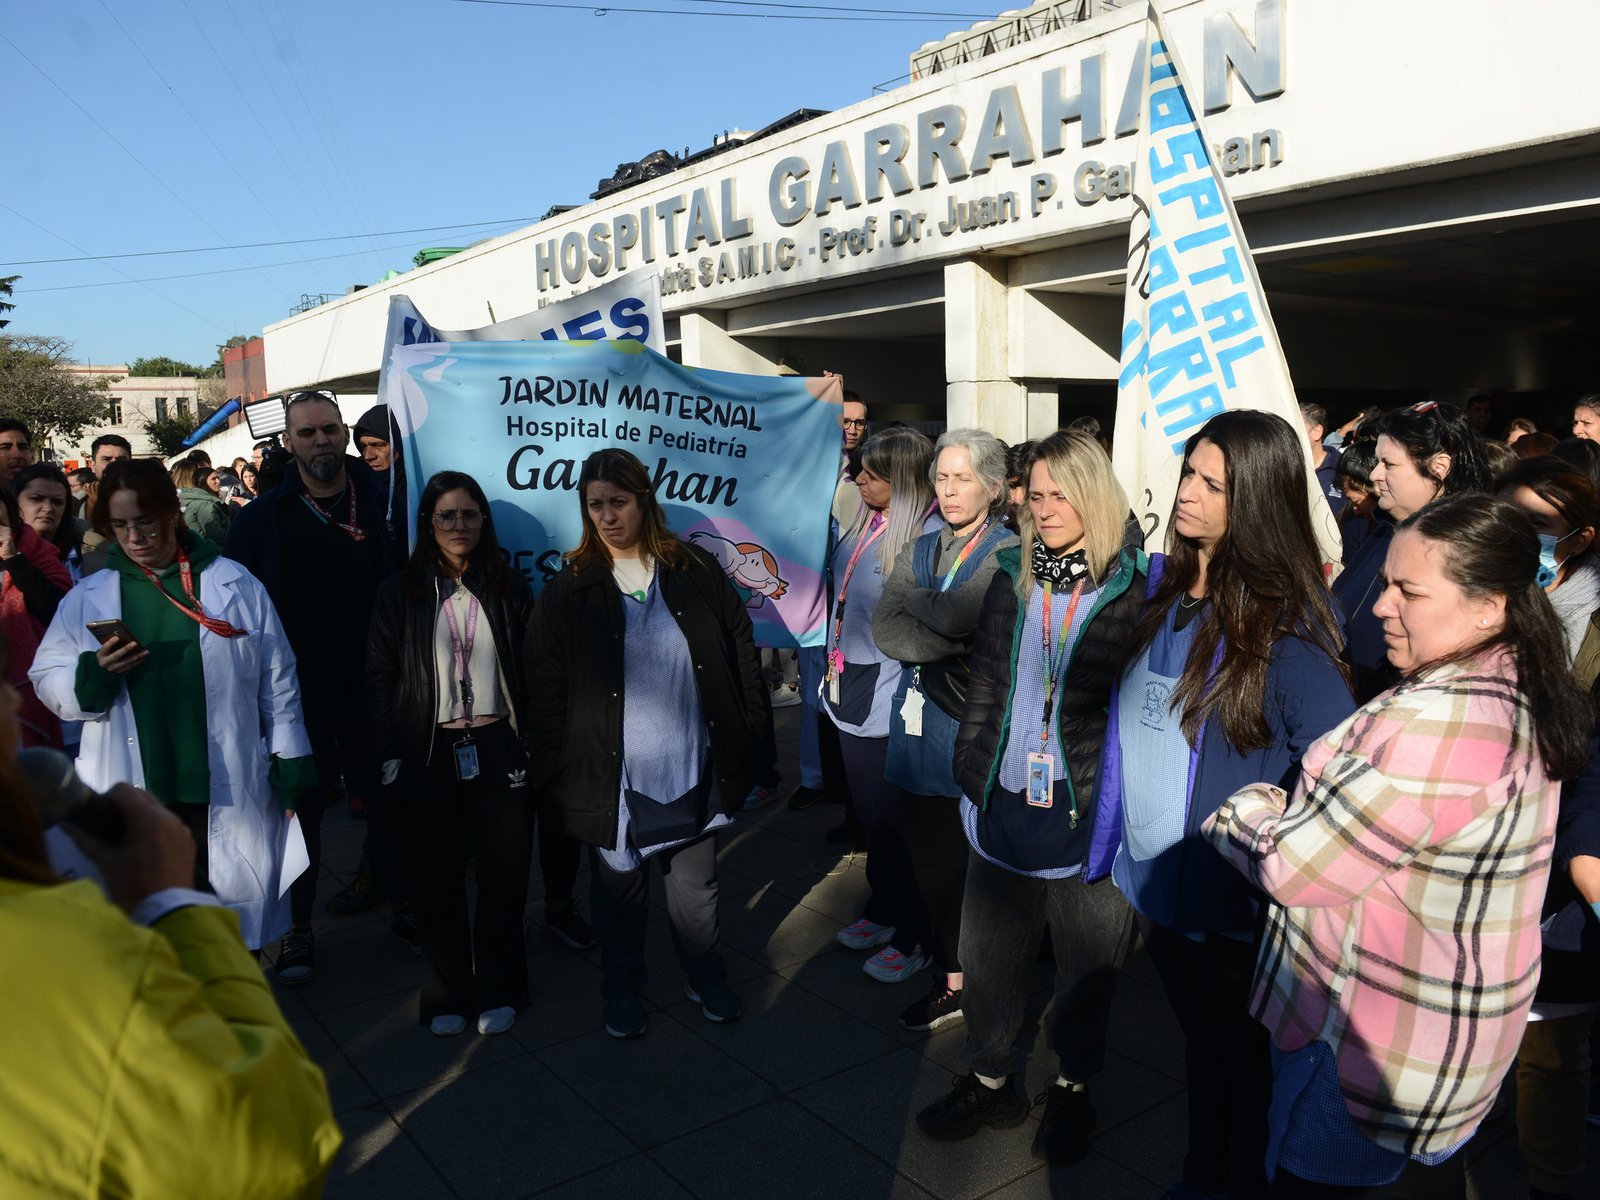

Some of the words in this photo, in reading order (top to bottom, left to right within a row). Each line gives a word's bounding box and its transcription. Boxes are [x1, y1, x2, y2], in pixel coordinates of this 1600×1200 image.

[819, 215, 884, 263] Prof.
[889, 209, 932, 248] Dr.
[938, 189, 1019, 237] Juan
[1031, 172, 1064, 218] P.
[1073, 128, 1284, 208] Gaan
[535, 176, 753, 292] HOSPITAL
[498, 376, 610, 408] JARDIN
[617, 384, 763, 432] MATERNAL
[507, 416, 608, 441] Hospital
[615, 421, 641, 442] de
[649, 425, 748, 458] Pediatría
[506, 444, 739, 508] Gahan
[1043, 614, 1051, 645] Garrahan
